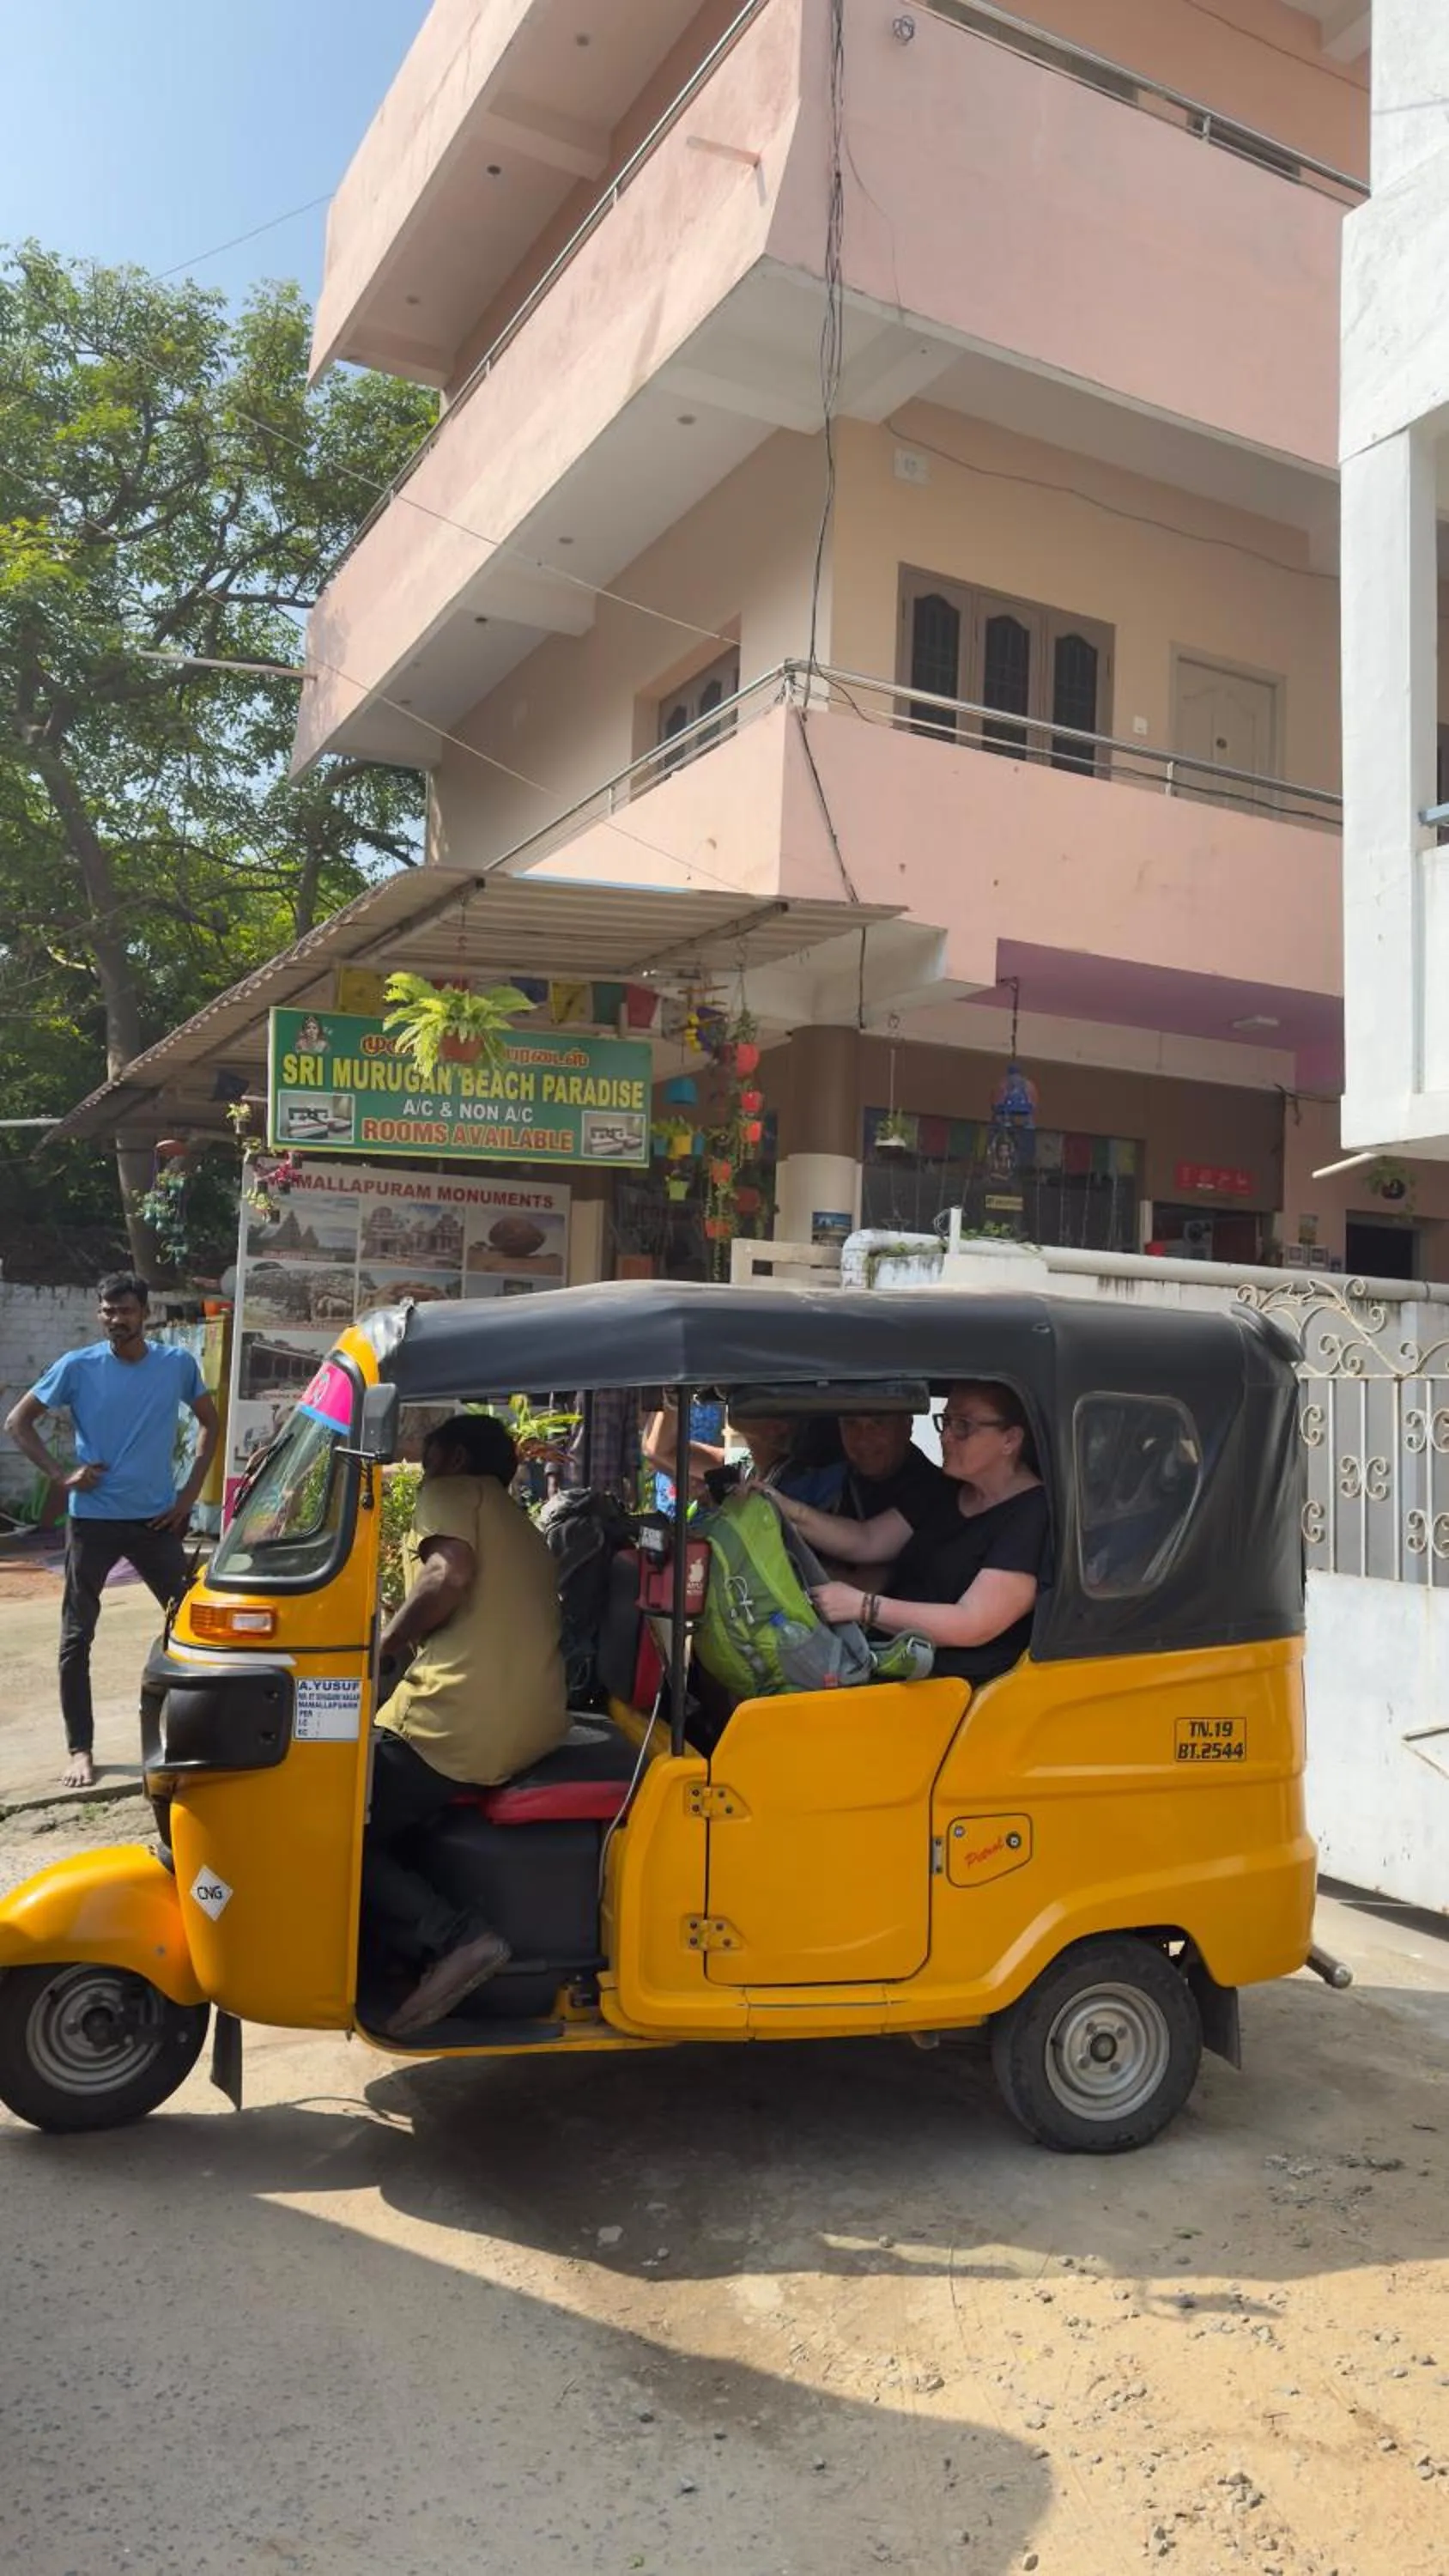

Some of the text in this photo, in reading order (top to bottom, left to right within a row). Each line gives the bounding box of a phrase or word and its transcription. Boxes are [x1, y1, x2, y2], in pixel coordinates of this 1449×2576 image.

[282, 1054, 645, 1109] SRI MURUGAN BEACH PARADISE
[403, 1098, 534, 1123] A/C & NON A/C
[361, 1117, 575, 1152] ROOMS AVAILABLE
[268, 1173, 554, 1210] MALLAPURAM MONUMENTS
[1189, 1720, 1234, 1737] TN.19
[1178, 1742, 1244, 1759] BT.2544
[197, 1885, 223, 1900] CNG
